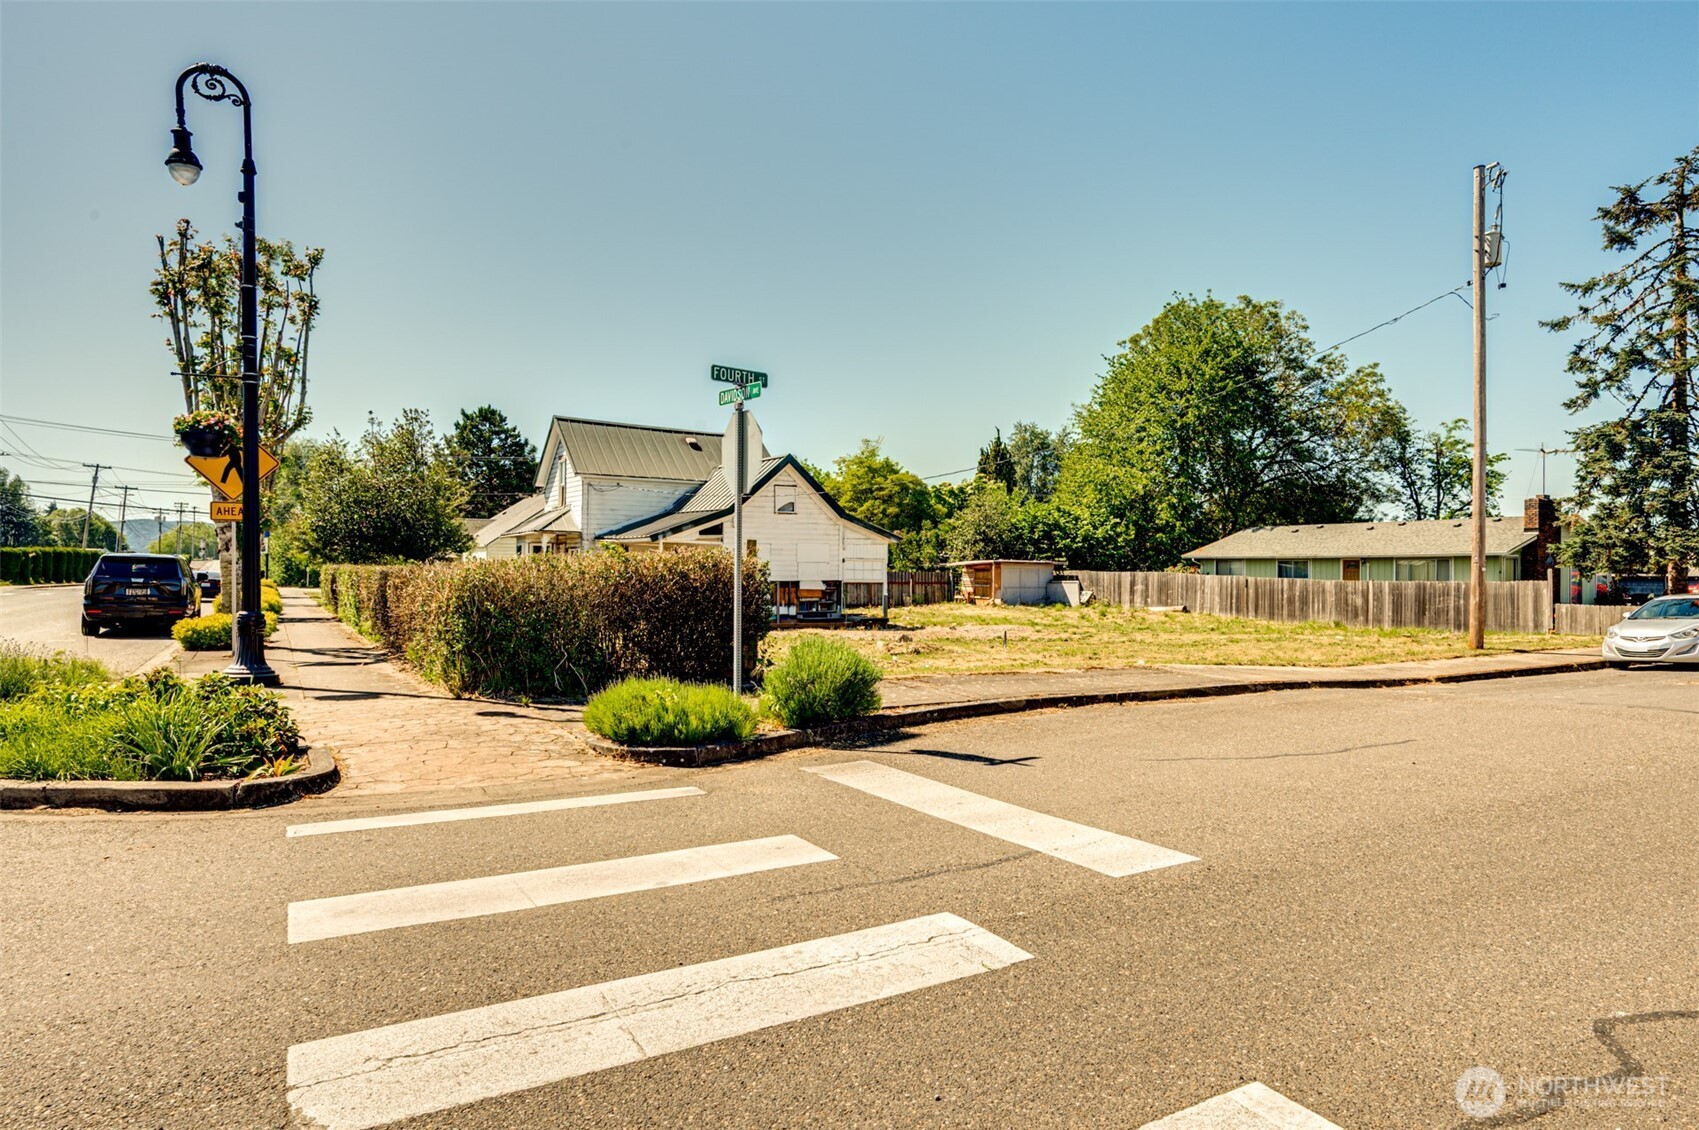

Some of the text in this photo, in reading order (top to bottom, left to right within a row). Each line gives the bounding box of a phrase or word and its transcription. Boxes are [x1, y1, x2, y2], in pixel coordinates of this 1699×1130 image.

[713, 367, 754, 383] FOURTH
[720, 386, 751, 405] DAVIDSON
[216, 506, 243, 517] AHEA
